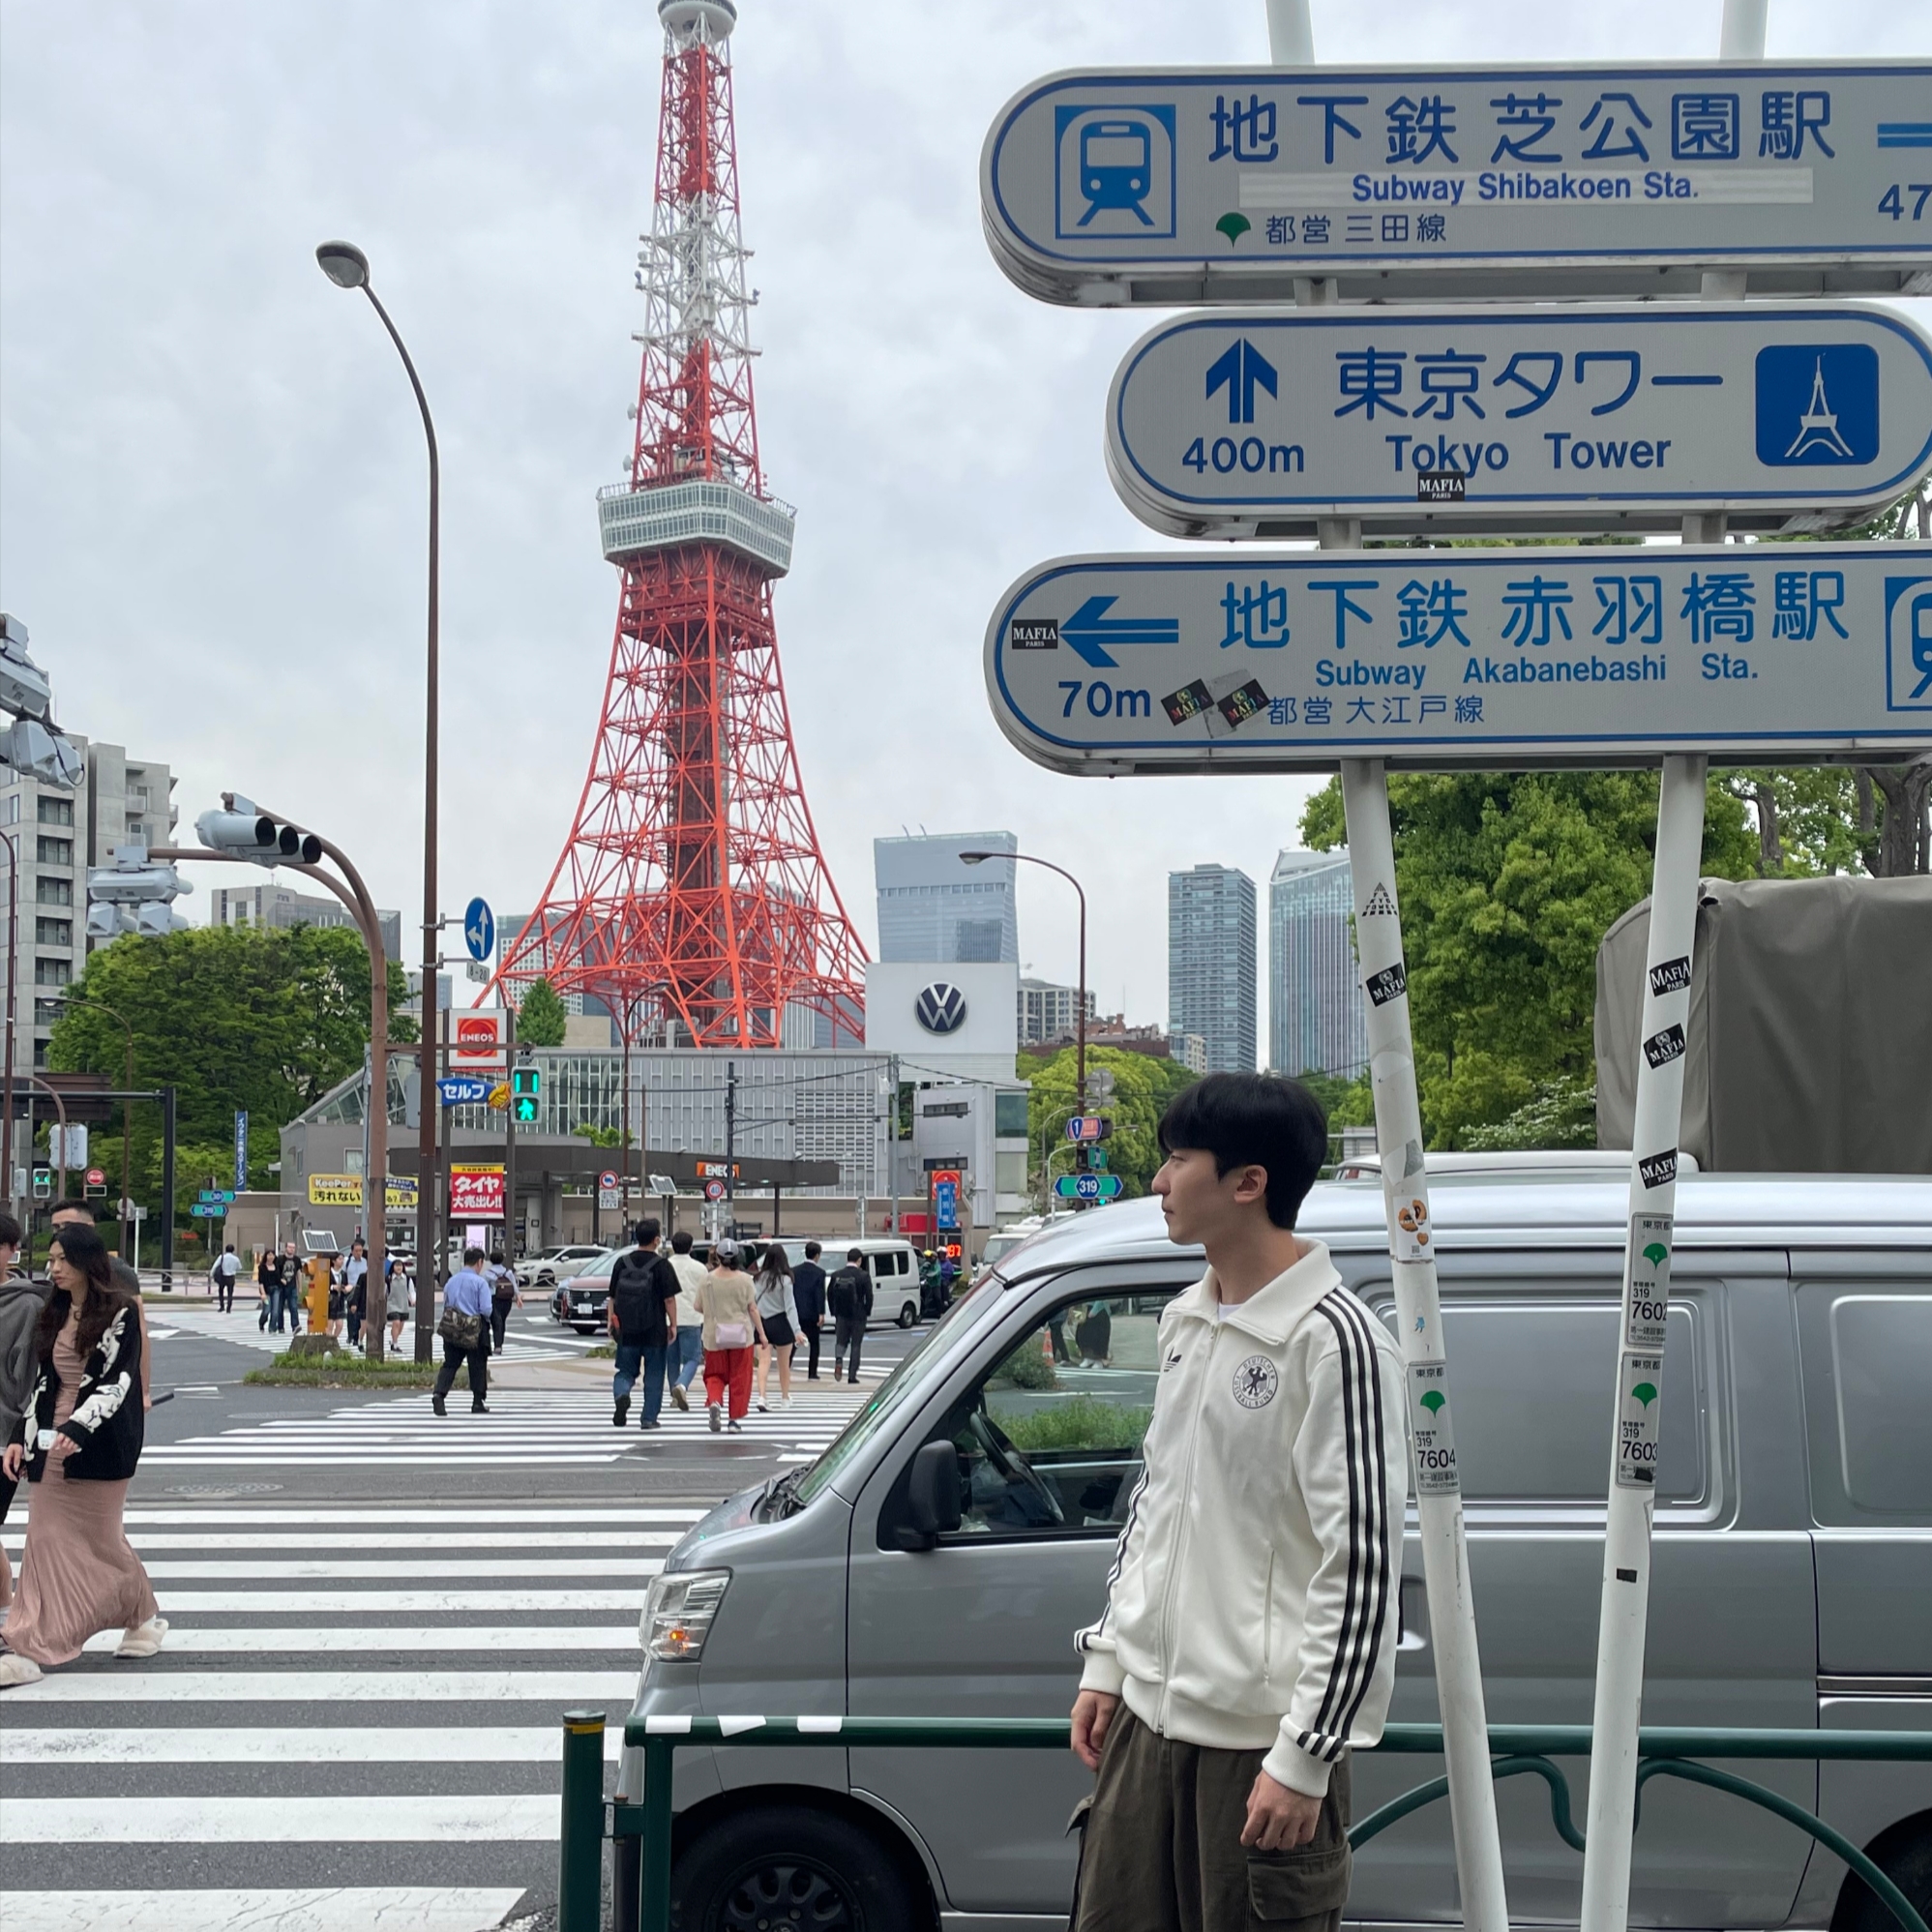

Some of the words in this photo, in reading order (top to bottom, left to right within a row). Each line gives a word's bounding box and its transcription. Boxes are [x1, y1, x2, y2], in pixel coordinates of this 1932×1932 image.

[1208, 91, 1458, 164] 地下鉄
[1490, 90, 1835, 163] 芝公園駅
[1352, 173, 1465, 206] Subway
[1478, 171, 1632, 200] Shibakoen
[1644, 171, 1700, 199] Sta.
[1334, 346, 1724, 421] 東京タワー
[1182, 435, 1304, 474] 400m
[1385, 433, 1509, 478] Tokyo
[1544, 432, 1671, 471] Tower
[1418, 478, 1464, 492] MAFIA
[1219, 578, 1471, 651] 地下鉄
[1501, 569, 1851, 650] 赤羽橋駅
[1013, 627, 1057, 640] MAFIA
[1315, 659, 1427, 691] Subway
[1463, 653, 1668, 684] Akabanebashi
[1701, 650, 1759, 681] Sta.
[1058, 680, 1151, 718] 70m
[1171, 695, 1208, 720] MAFIA
[1228, 694, 1265, 721] MAFIA
[1651, 962, 1691, 989] MAFIA
[1667, 979, 1684, 991] PARIS
[1373, 977, 1405, 1000] MAFIA
[460, 1032, 494, 1043] ENEOS
[1649, 1039, 1684, 1062] MAFIA
[1664, 1051, 1679, 1062] PARIS
[442, 1084, 486, 1100] セルフ
[1074, 1120, 1080, 1135] 1
[454, 1174, 500, 1194] タイヤ
[711, 1185, 722, 1195] 40
[1079, 1180, 1098, 1194] 319
[1633, 1288, 1650, 1298] 319
[1415, 1367, 1444, 1379] 東京都
[1631, 1359, 1661, 1370] 東京都
[1416, 1437, 1433, 1447] 319
[1623, 1427, 1640, 1439] 319
[1417, 1448, 1456, 1470] 7604
[1621, 1441, 1658, 1462] 7603
